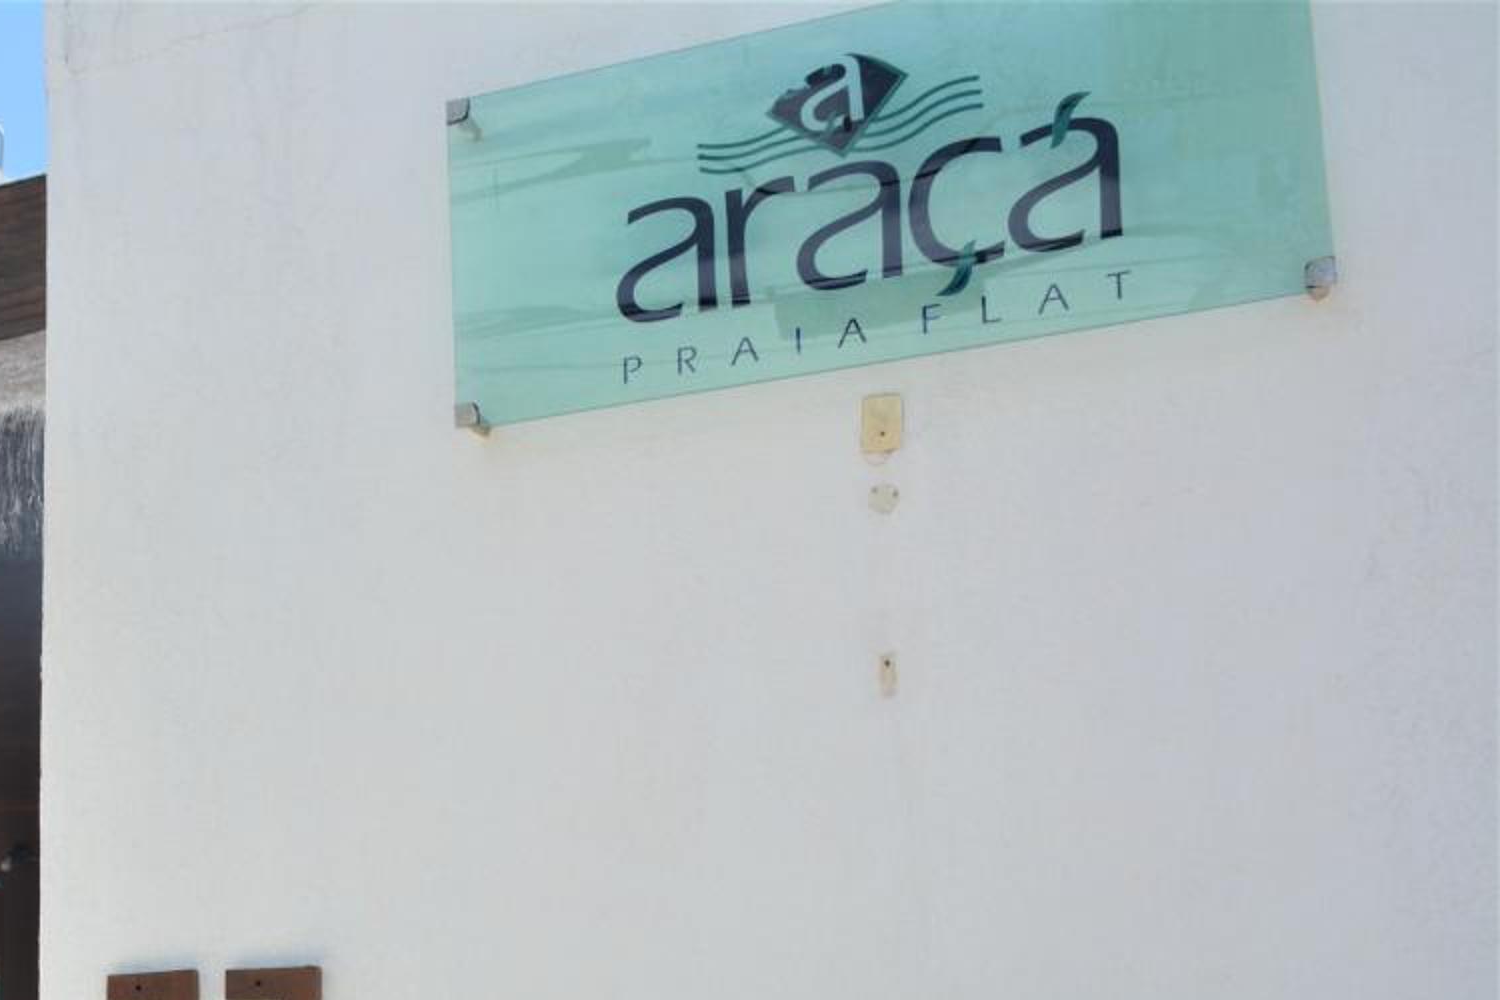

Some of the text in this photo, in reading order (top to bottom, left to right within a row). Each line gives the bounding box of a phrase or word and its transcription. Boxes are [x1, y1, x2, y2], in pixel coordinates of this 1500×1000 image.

[615, 90, 1124, 323] araçá
[621, 269, 1132, 384] PRAIA FLAT
